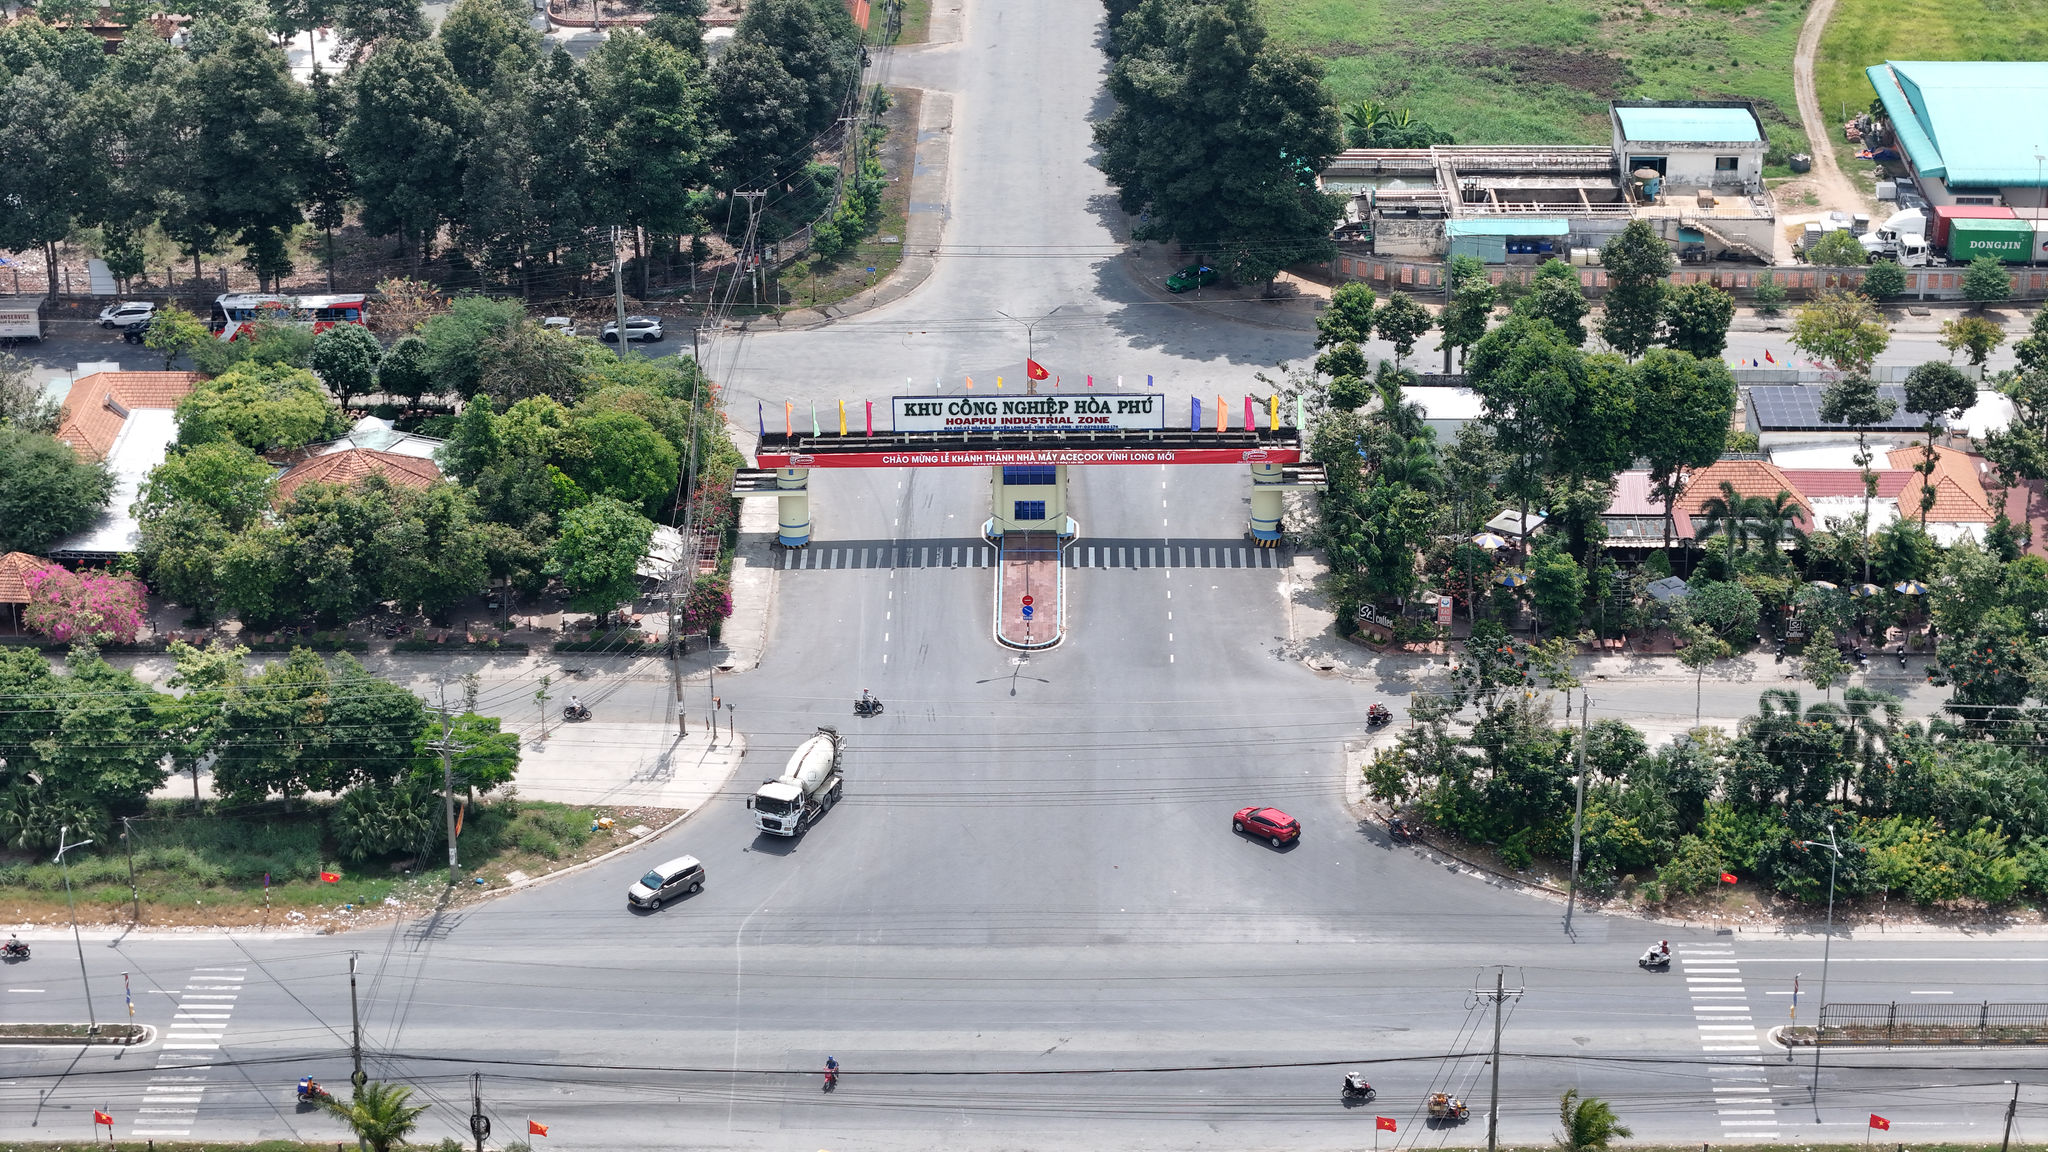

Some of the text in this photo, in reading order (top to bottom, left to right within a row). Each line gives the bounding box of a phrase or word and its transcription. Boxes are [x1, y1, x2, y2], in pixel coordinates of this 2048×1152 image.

[1969, 240, 2022, 250] DONGJIN
[904, 396, 1153, 417] KHU CÔNG NGHIỆP HÒA PHÚ
[945, 416, 1110, 425] HOAPHU INDUSTRIAL ZONE
[882, 451, 1175, 464] CHÀO MỪNG LỄ KHÁNH THÀNH NHÀ MÁY ACECOOK VĨNH LONG MỚI
[1360, 606, 1373, 620] St.
